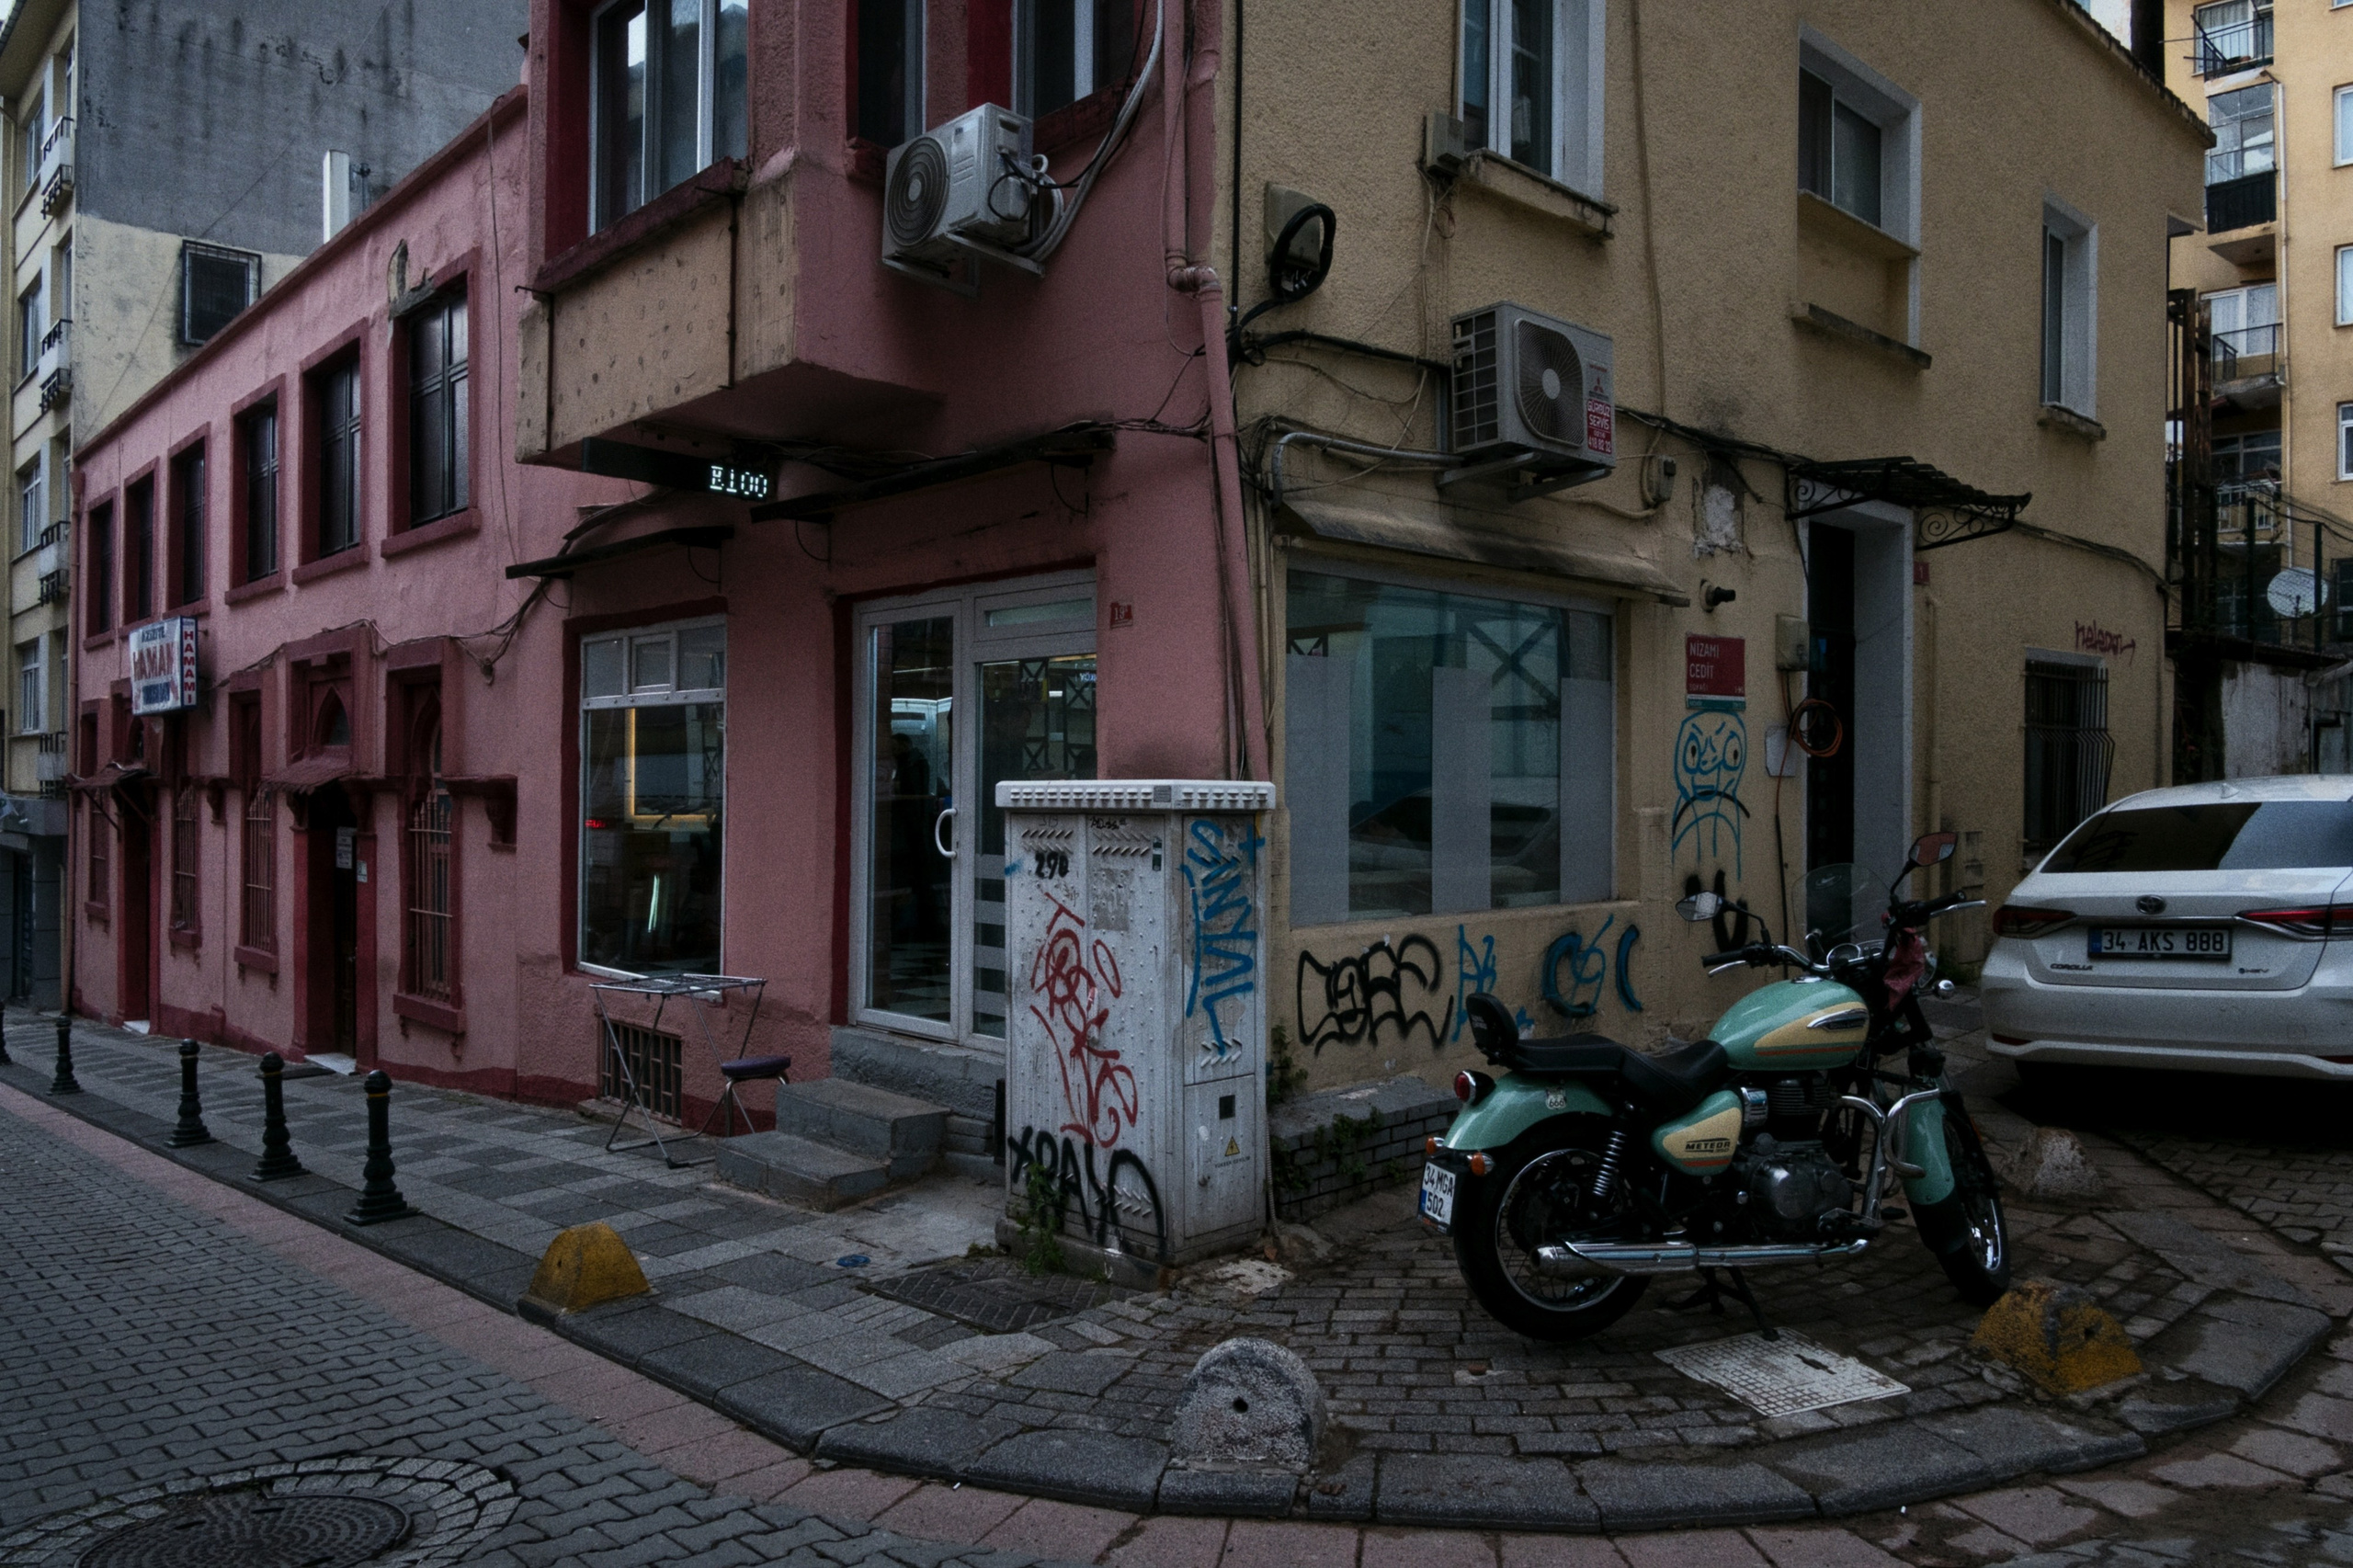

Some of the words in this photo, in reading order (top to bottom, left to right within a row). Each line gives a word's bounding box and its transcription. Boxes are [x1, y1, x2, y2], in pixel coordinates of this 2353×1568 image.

[184, 631, 195, 704] HAMAMI
[1689, 662, 1714, 679] CEDİT
[2103, 931, 2126, 950] 34
[2137, 931, 2175, 951] AKS
[2186, 931, 2224, 951] 888
[1685, 1142, 1731, 1150] METEOR
[1424, 1165, 1436, 1187] 34
[1427, 1191, 1444, 1218] 502
